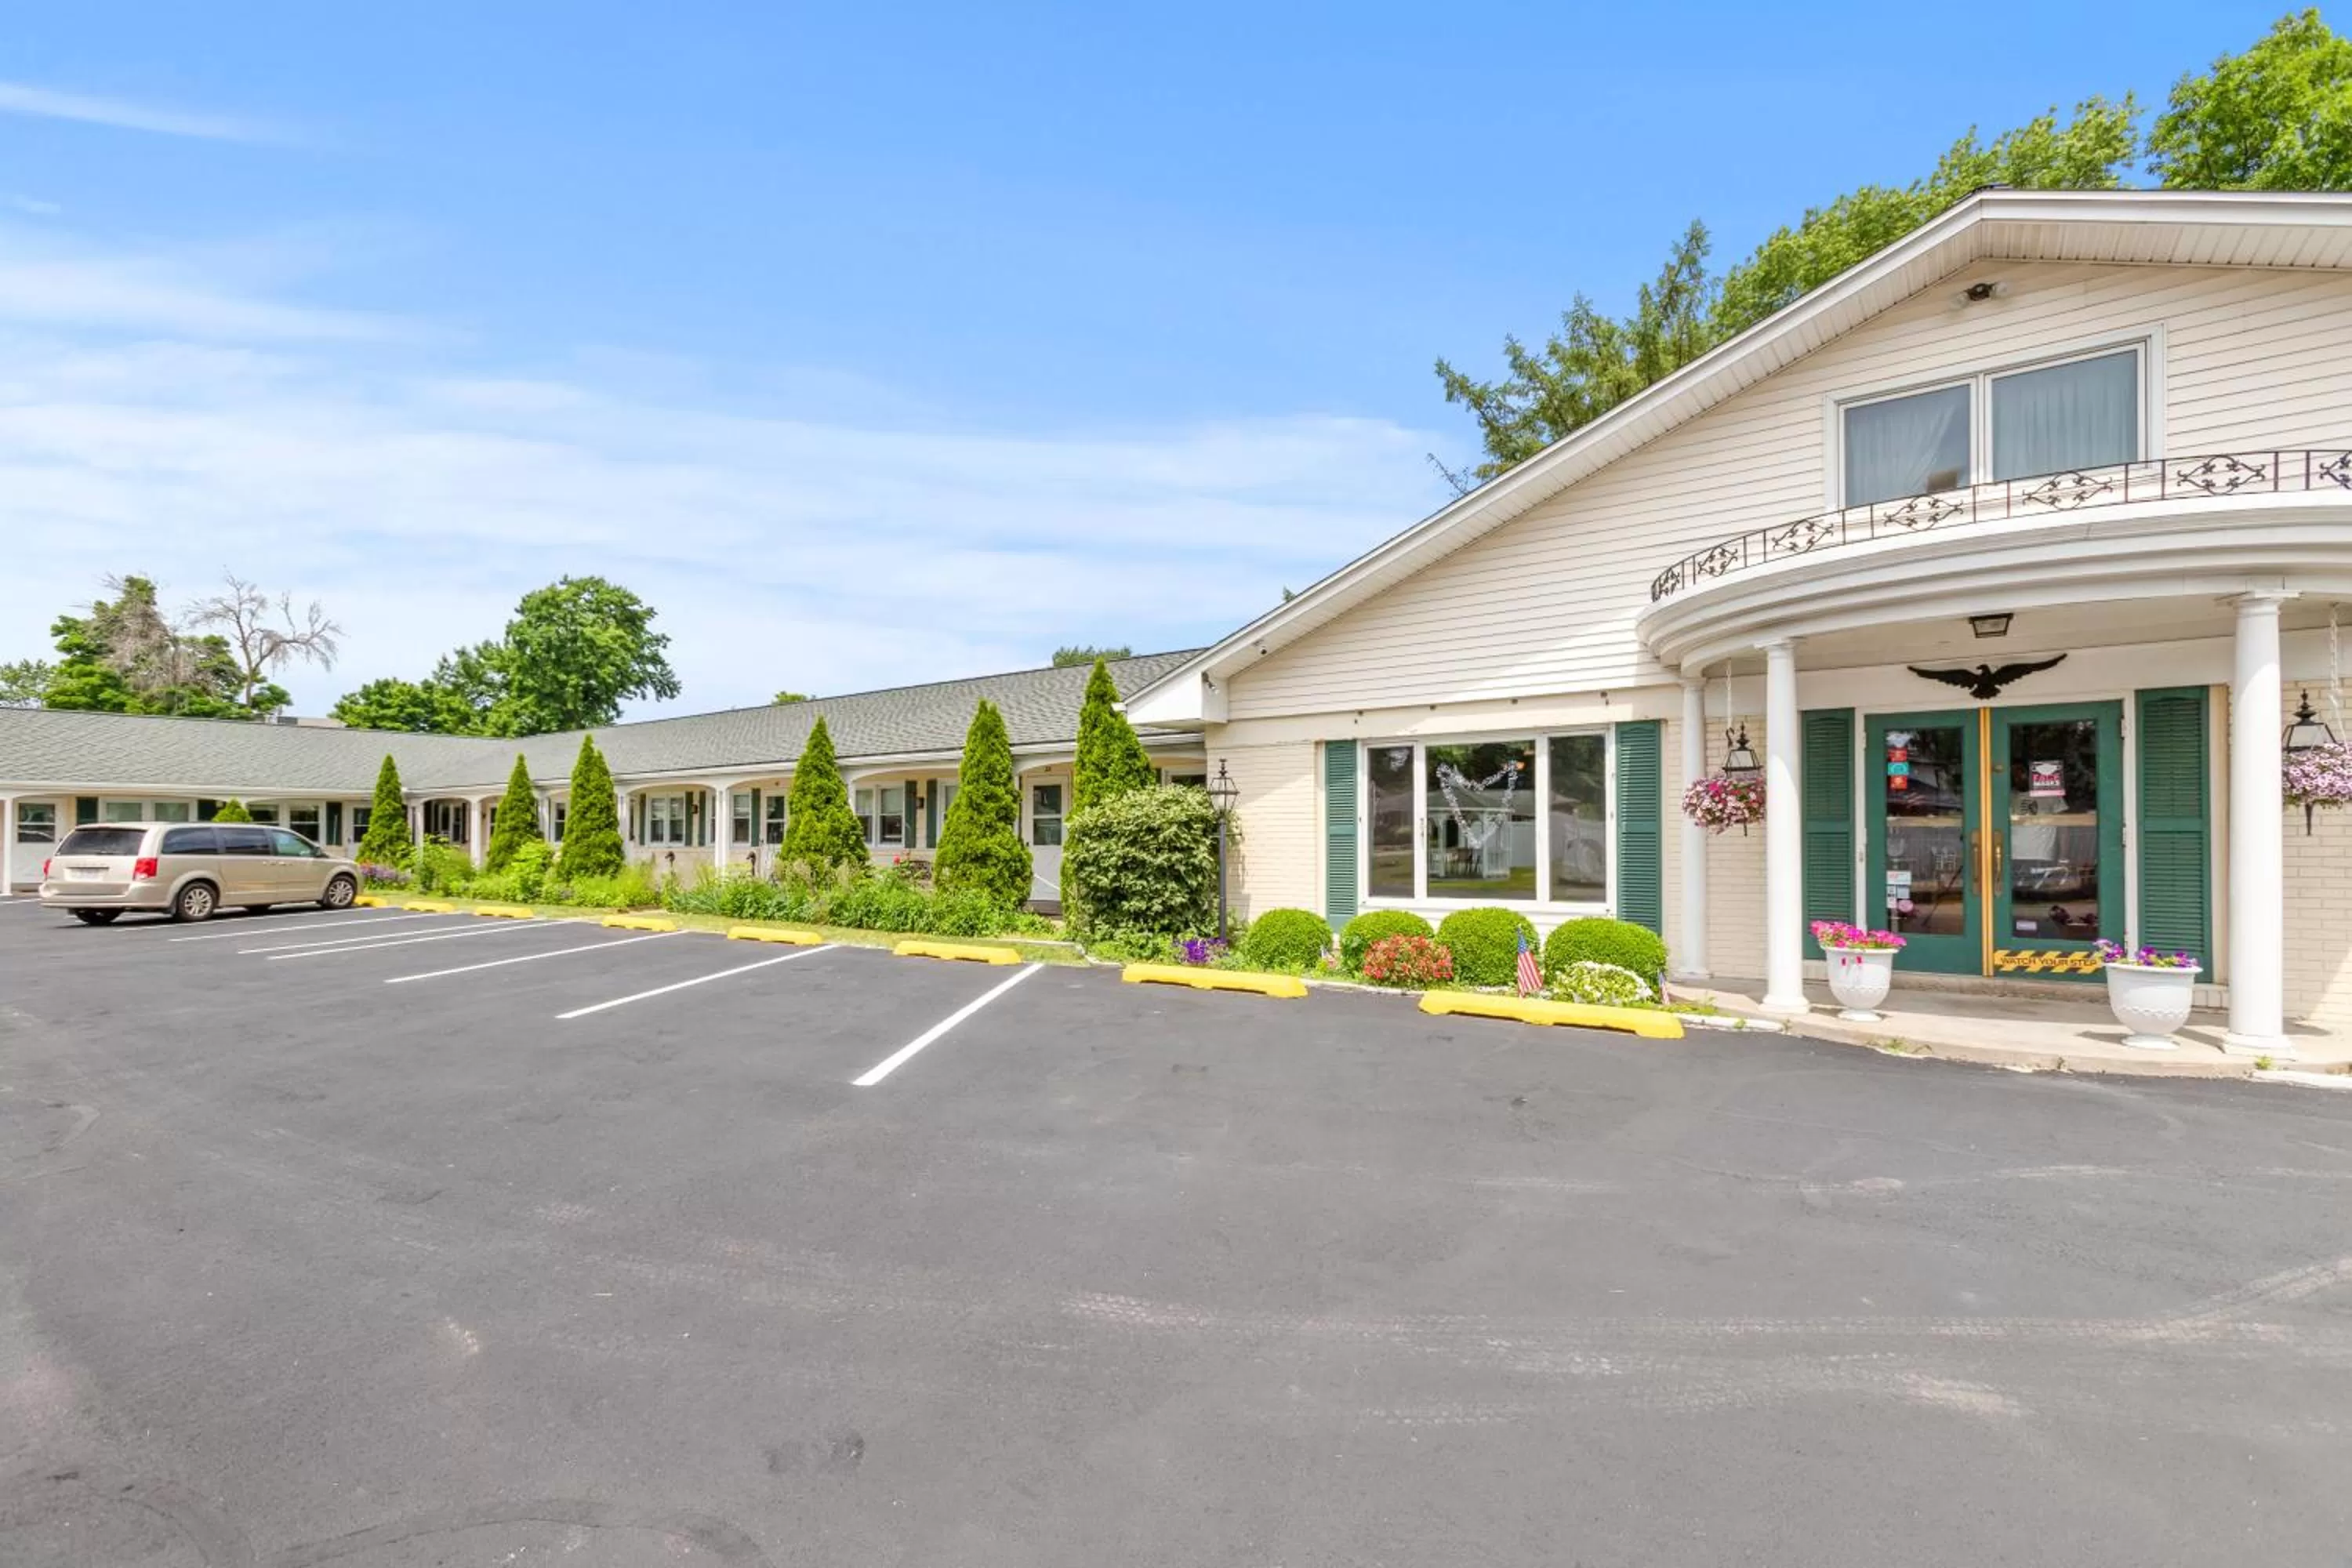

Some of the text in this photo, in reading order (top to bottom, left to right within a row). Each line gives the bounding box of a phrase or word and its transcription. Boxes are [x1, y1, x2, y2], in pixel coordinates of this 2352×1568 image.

[2000, 956, 2097, 967] WATCH YOUR STEP
